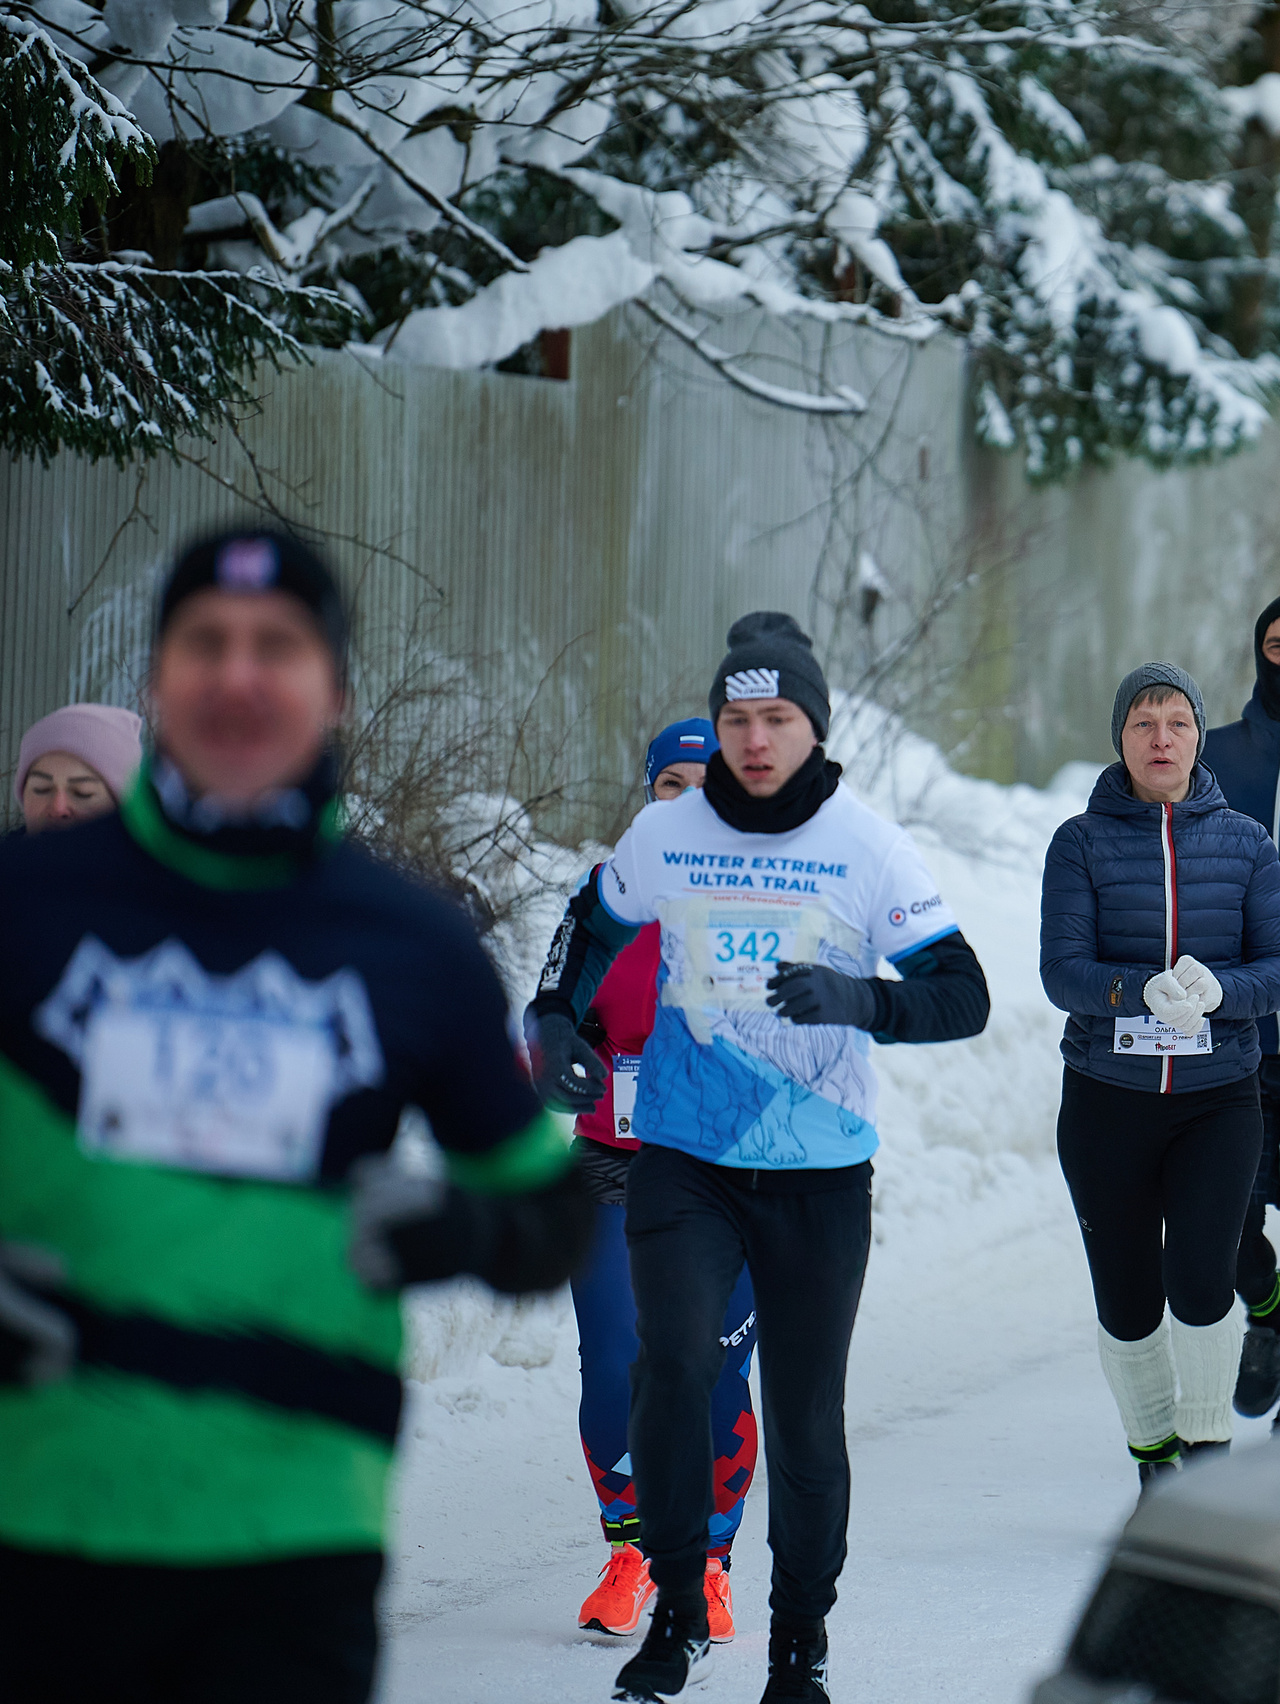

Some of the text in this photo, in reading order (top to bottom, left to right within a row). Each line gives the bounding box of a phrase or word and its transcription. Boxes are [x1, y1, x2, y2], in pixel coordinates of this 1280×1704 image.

[663, 851, 848, 878] WINTER EXTREME
[689, 872, 820, 894] ULTRA TRAIL
[716, 931, 781, 962] 342
